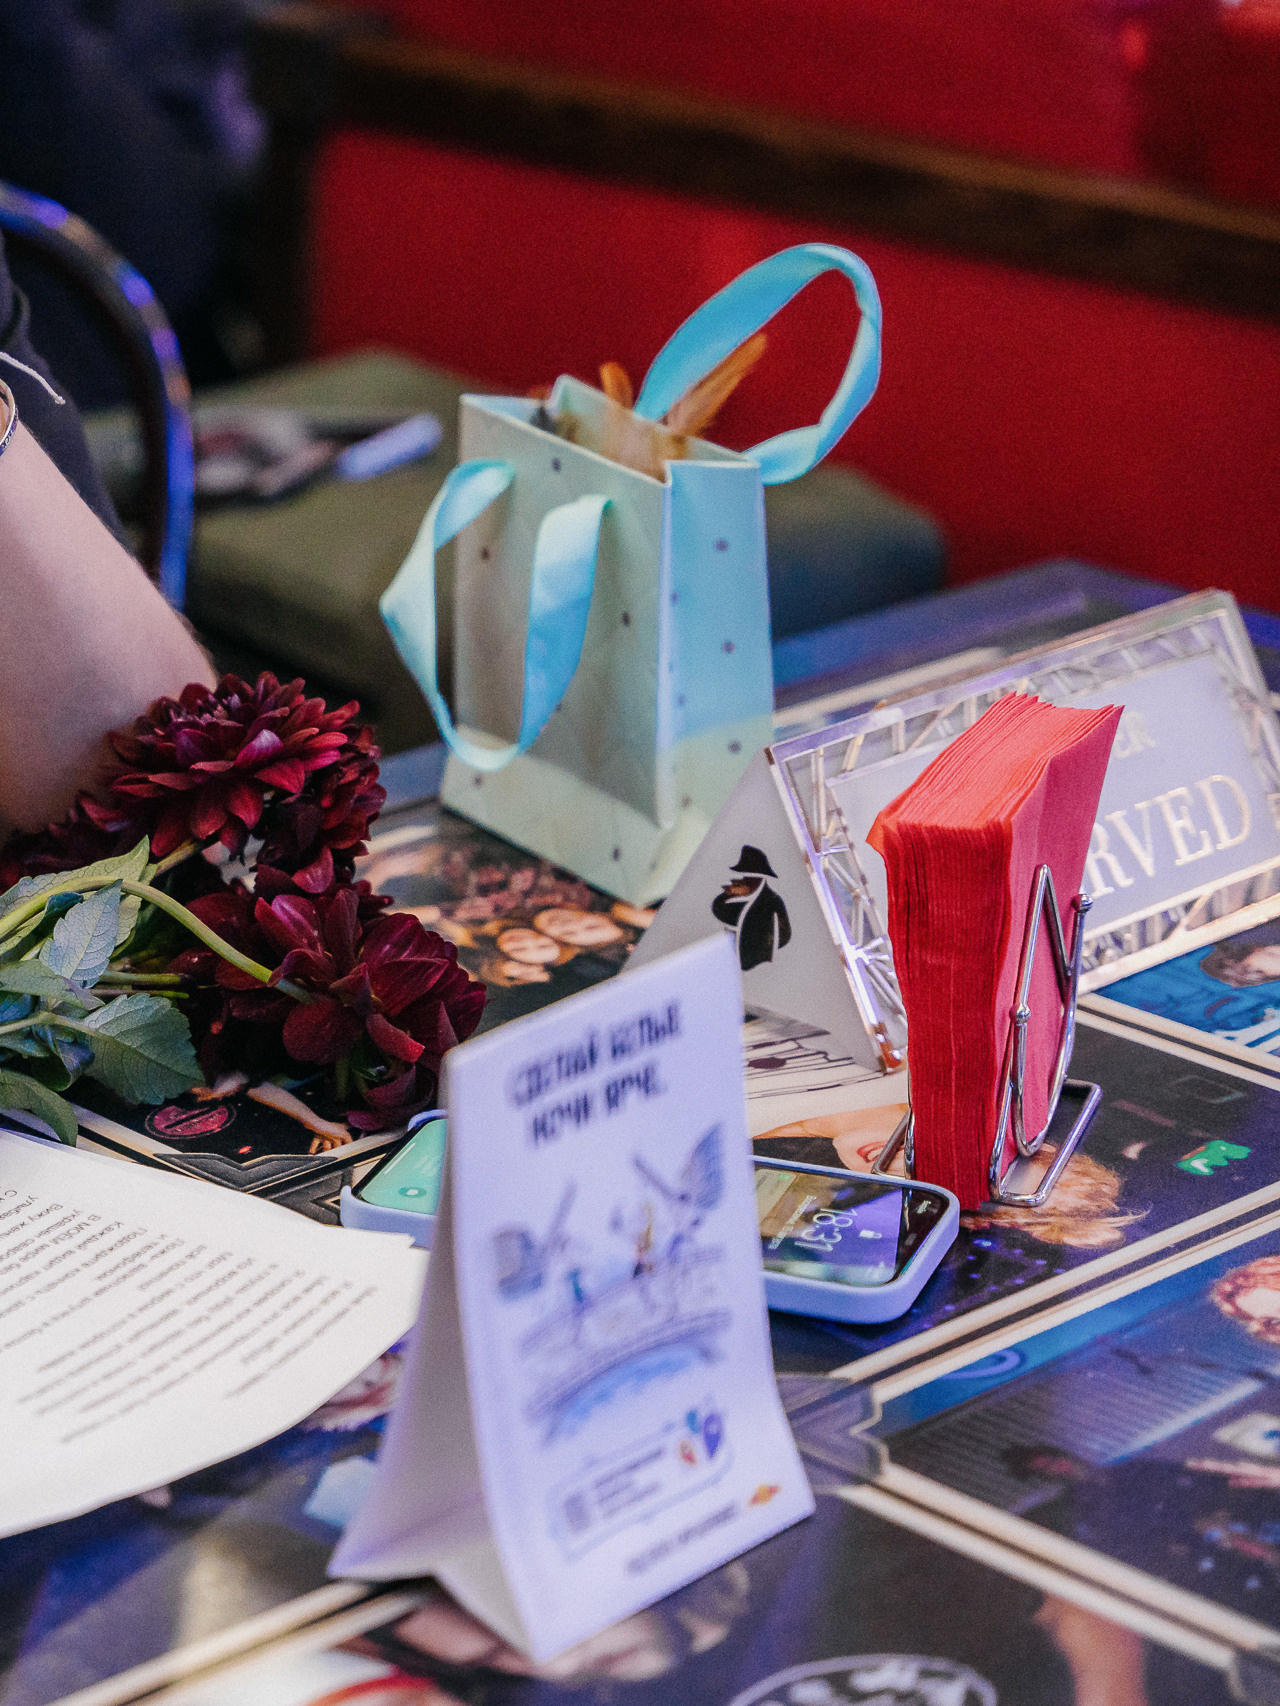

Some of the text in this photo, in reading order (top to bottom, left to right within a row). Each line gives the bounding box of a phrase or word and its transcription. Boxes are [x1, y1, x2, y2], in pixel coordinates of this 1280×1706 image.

[1085, 774, 1252, 898] RVED
[23, 1202, 65, 1222] Вижу
[30, 1209, 85, 1238] украшен
[72, 1221, 126, 1250] Каждый
[794, 1207, 859, 1252] 18:31
[14, 1242, 53, 1262] мире
